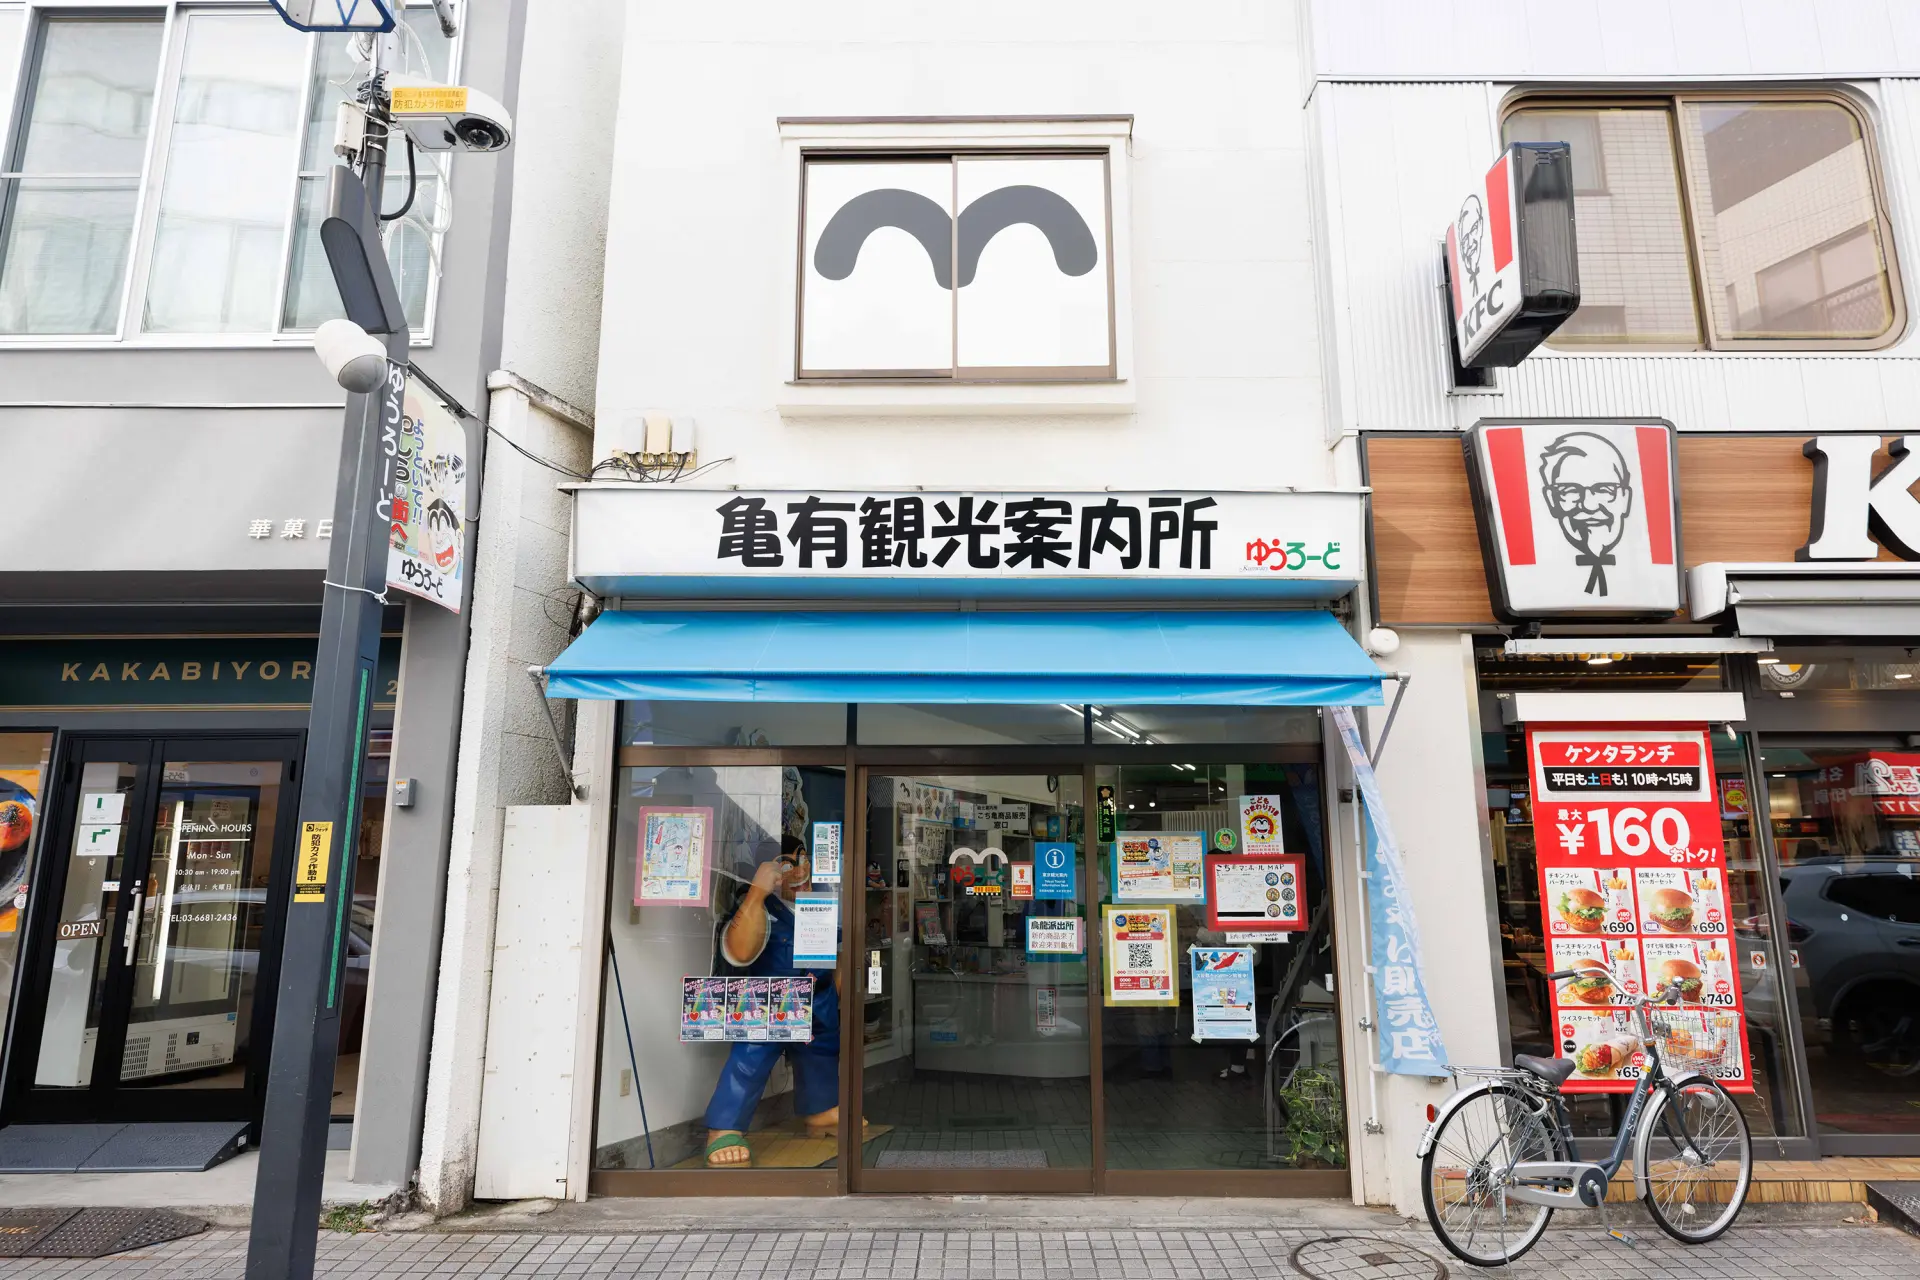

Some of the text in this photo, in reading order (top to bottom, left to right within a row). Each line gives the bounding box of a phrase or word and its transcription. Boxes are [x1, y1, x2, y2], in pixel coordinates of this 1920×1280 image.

[393, 99, 464, 109] 防犯カメラ作動中
[1462, 279, 1504, 348] KFC
[375, 362, 405, 522] ゆうろーど
[716, 496, 1218, 569] 亀有観光案内所
[1246, 537, 1341, 571] ゆうろーど
[401, 558, 443, 599] ゆうろーど
[1565, 744, 1675, 763] ケンタランチ
[1552, 772, 1628, 786] 平日も土日も!
[1249, 796, 1270, 805] こども
[977, 811, 1027, 820] こち亀商品販売
[1557, 808, 1582, 821] 最大
[174, 823, 252, 833] PENING HOURS
[993, 821, 1009, 829] 窓口
[1556, 807, 1690, 856] ¥160
[188, 852, 207, 860] Mon
[216, 851, 231, 859] Sun
[306, 833, 321, 882] 防犯カメラ作動中
[1669, 847, 1717, 863] おトク!
[950, 866, 1006, 887] ゆうろーど
[61, 923, 100, 937] OPEN
[1602, 921, 1635, 933] ¥690
[1693, 921, 1725, 933] ¥690
[1700, 993, 1734, 1005] ¥740
[1616, 1066, 1641, 1078] ¥65
